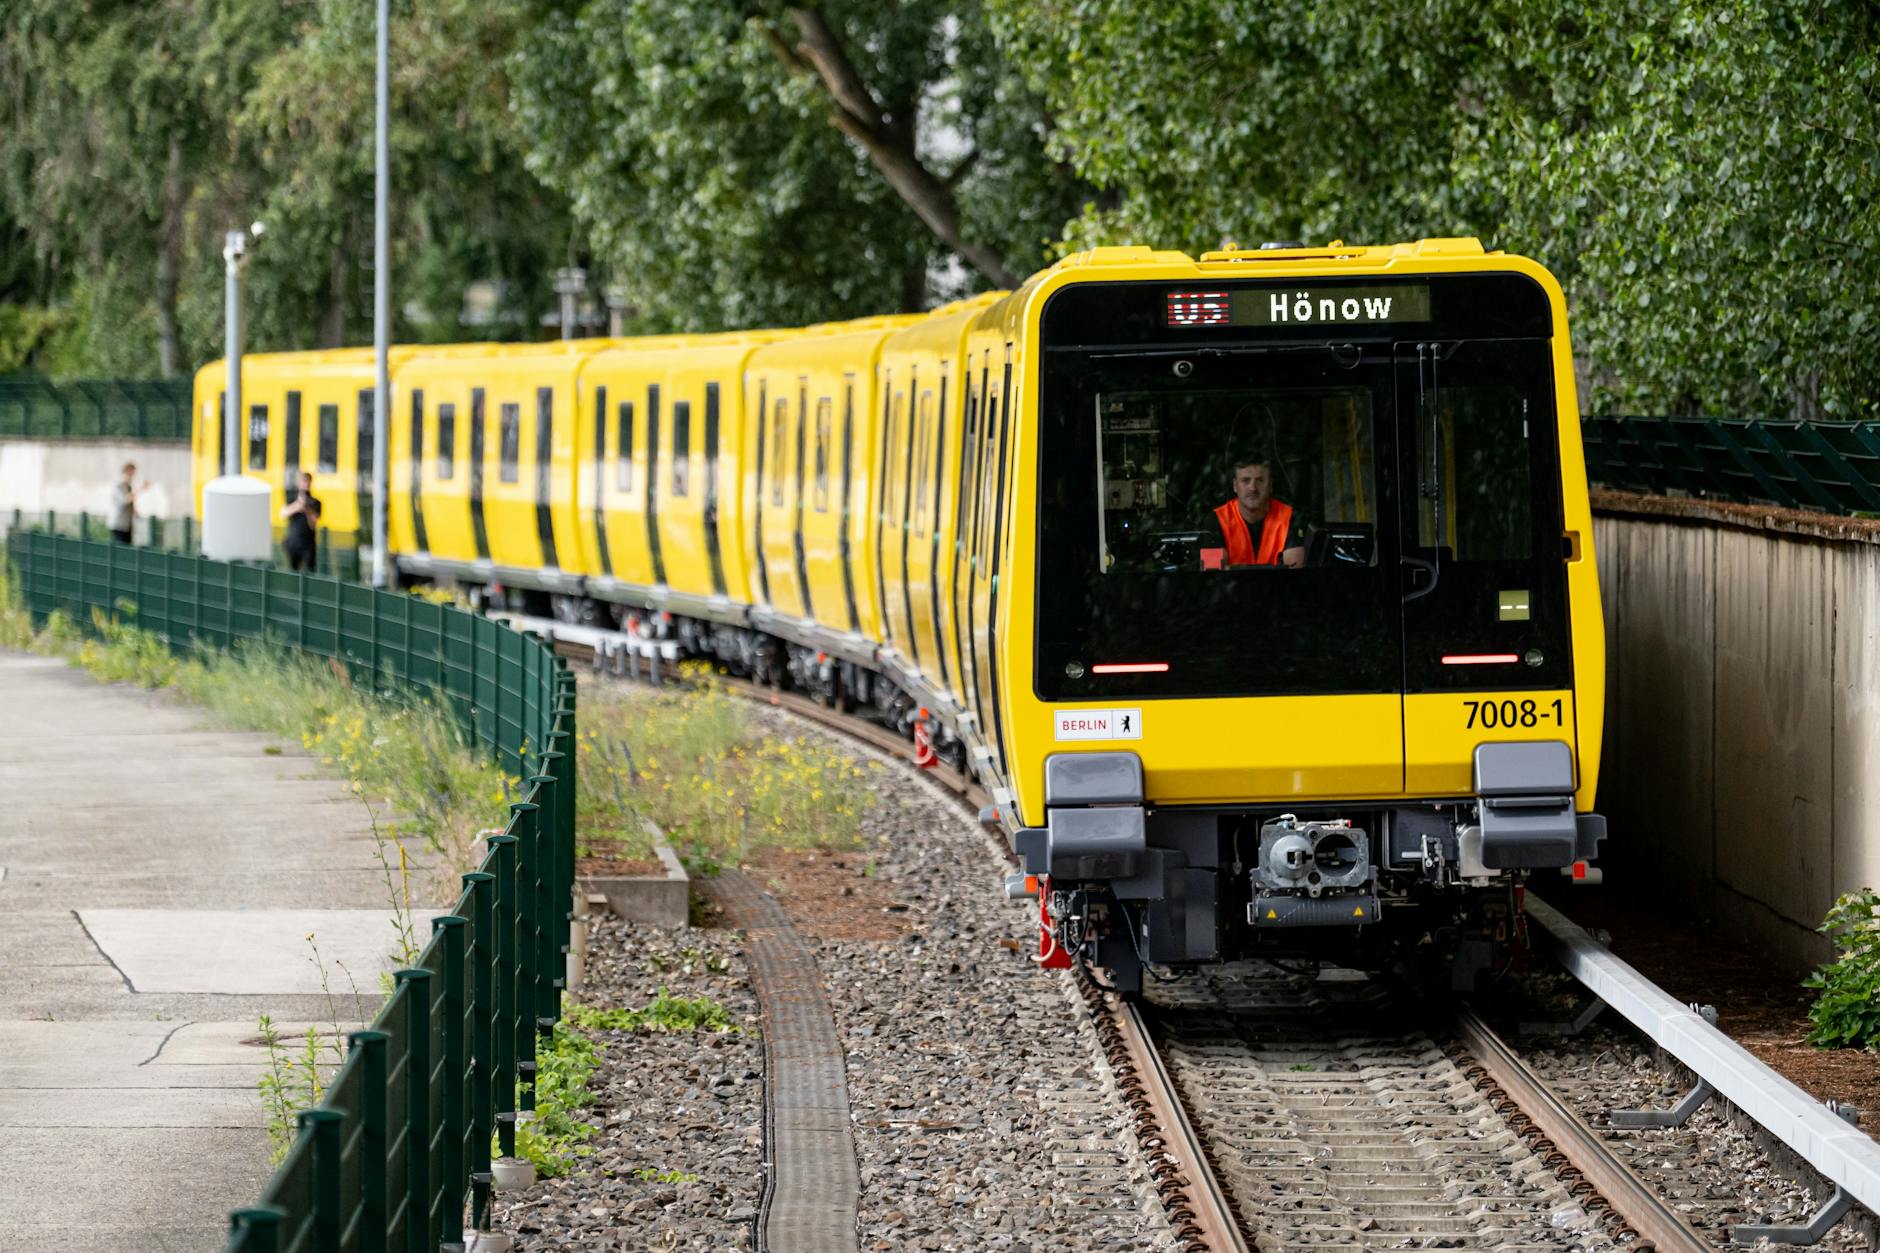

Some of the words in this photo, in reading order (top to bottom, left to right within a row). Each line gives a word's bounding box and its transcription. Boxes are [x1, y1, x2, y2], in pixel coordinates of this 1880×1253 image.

[1270, 292, 1392, 322] Hönow
[1062, 720, 1107, 731] BERLIN
[1463, 699, 1563, 729] 7008-1
